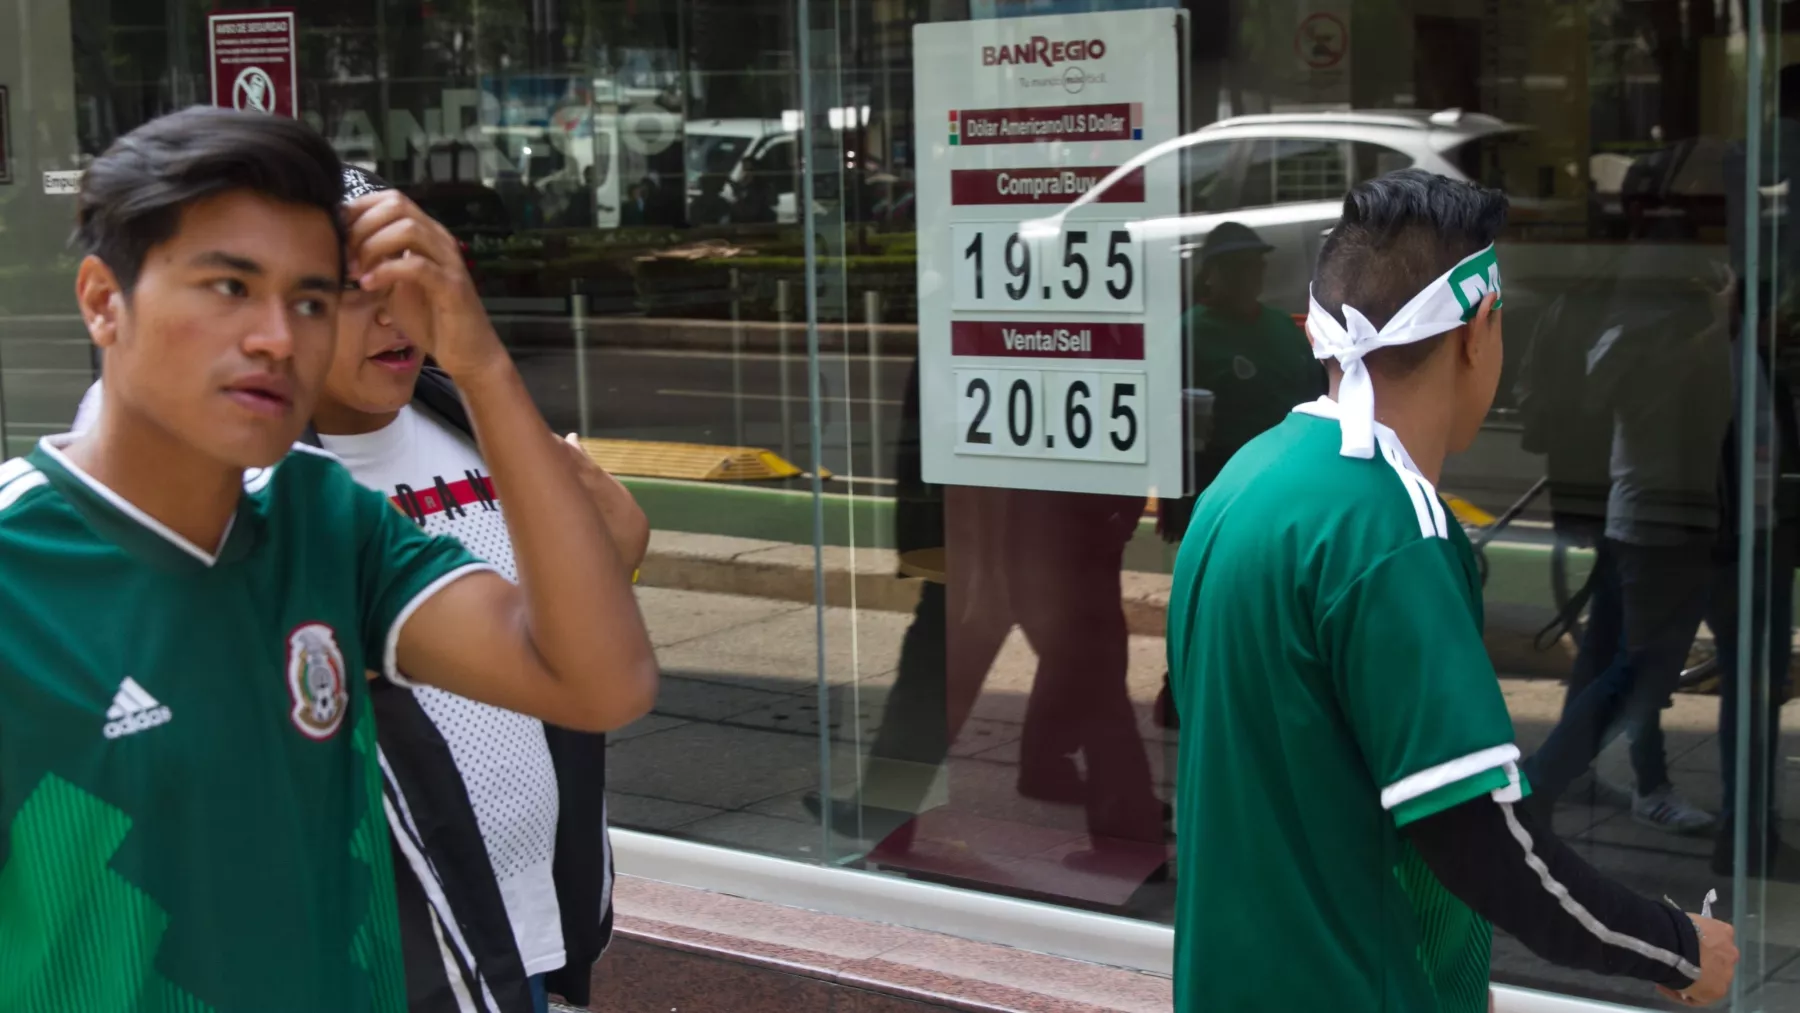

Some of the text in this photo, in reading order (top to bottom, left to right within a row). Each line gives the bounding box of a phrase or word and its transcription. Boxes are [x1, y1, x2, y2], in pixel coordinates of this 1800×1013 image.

[982, 36, 1105, 67] BANREGIO
[1088, 113, 1125, 133] Dollar
[965, 231, 1134, 301] 19.55
[1002, 328, 1092, 352] Venta/Sell
[965, 378, 1138, 452] 20.65
